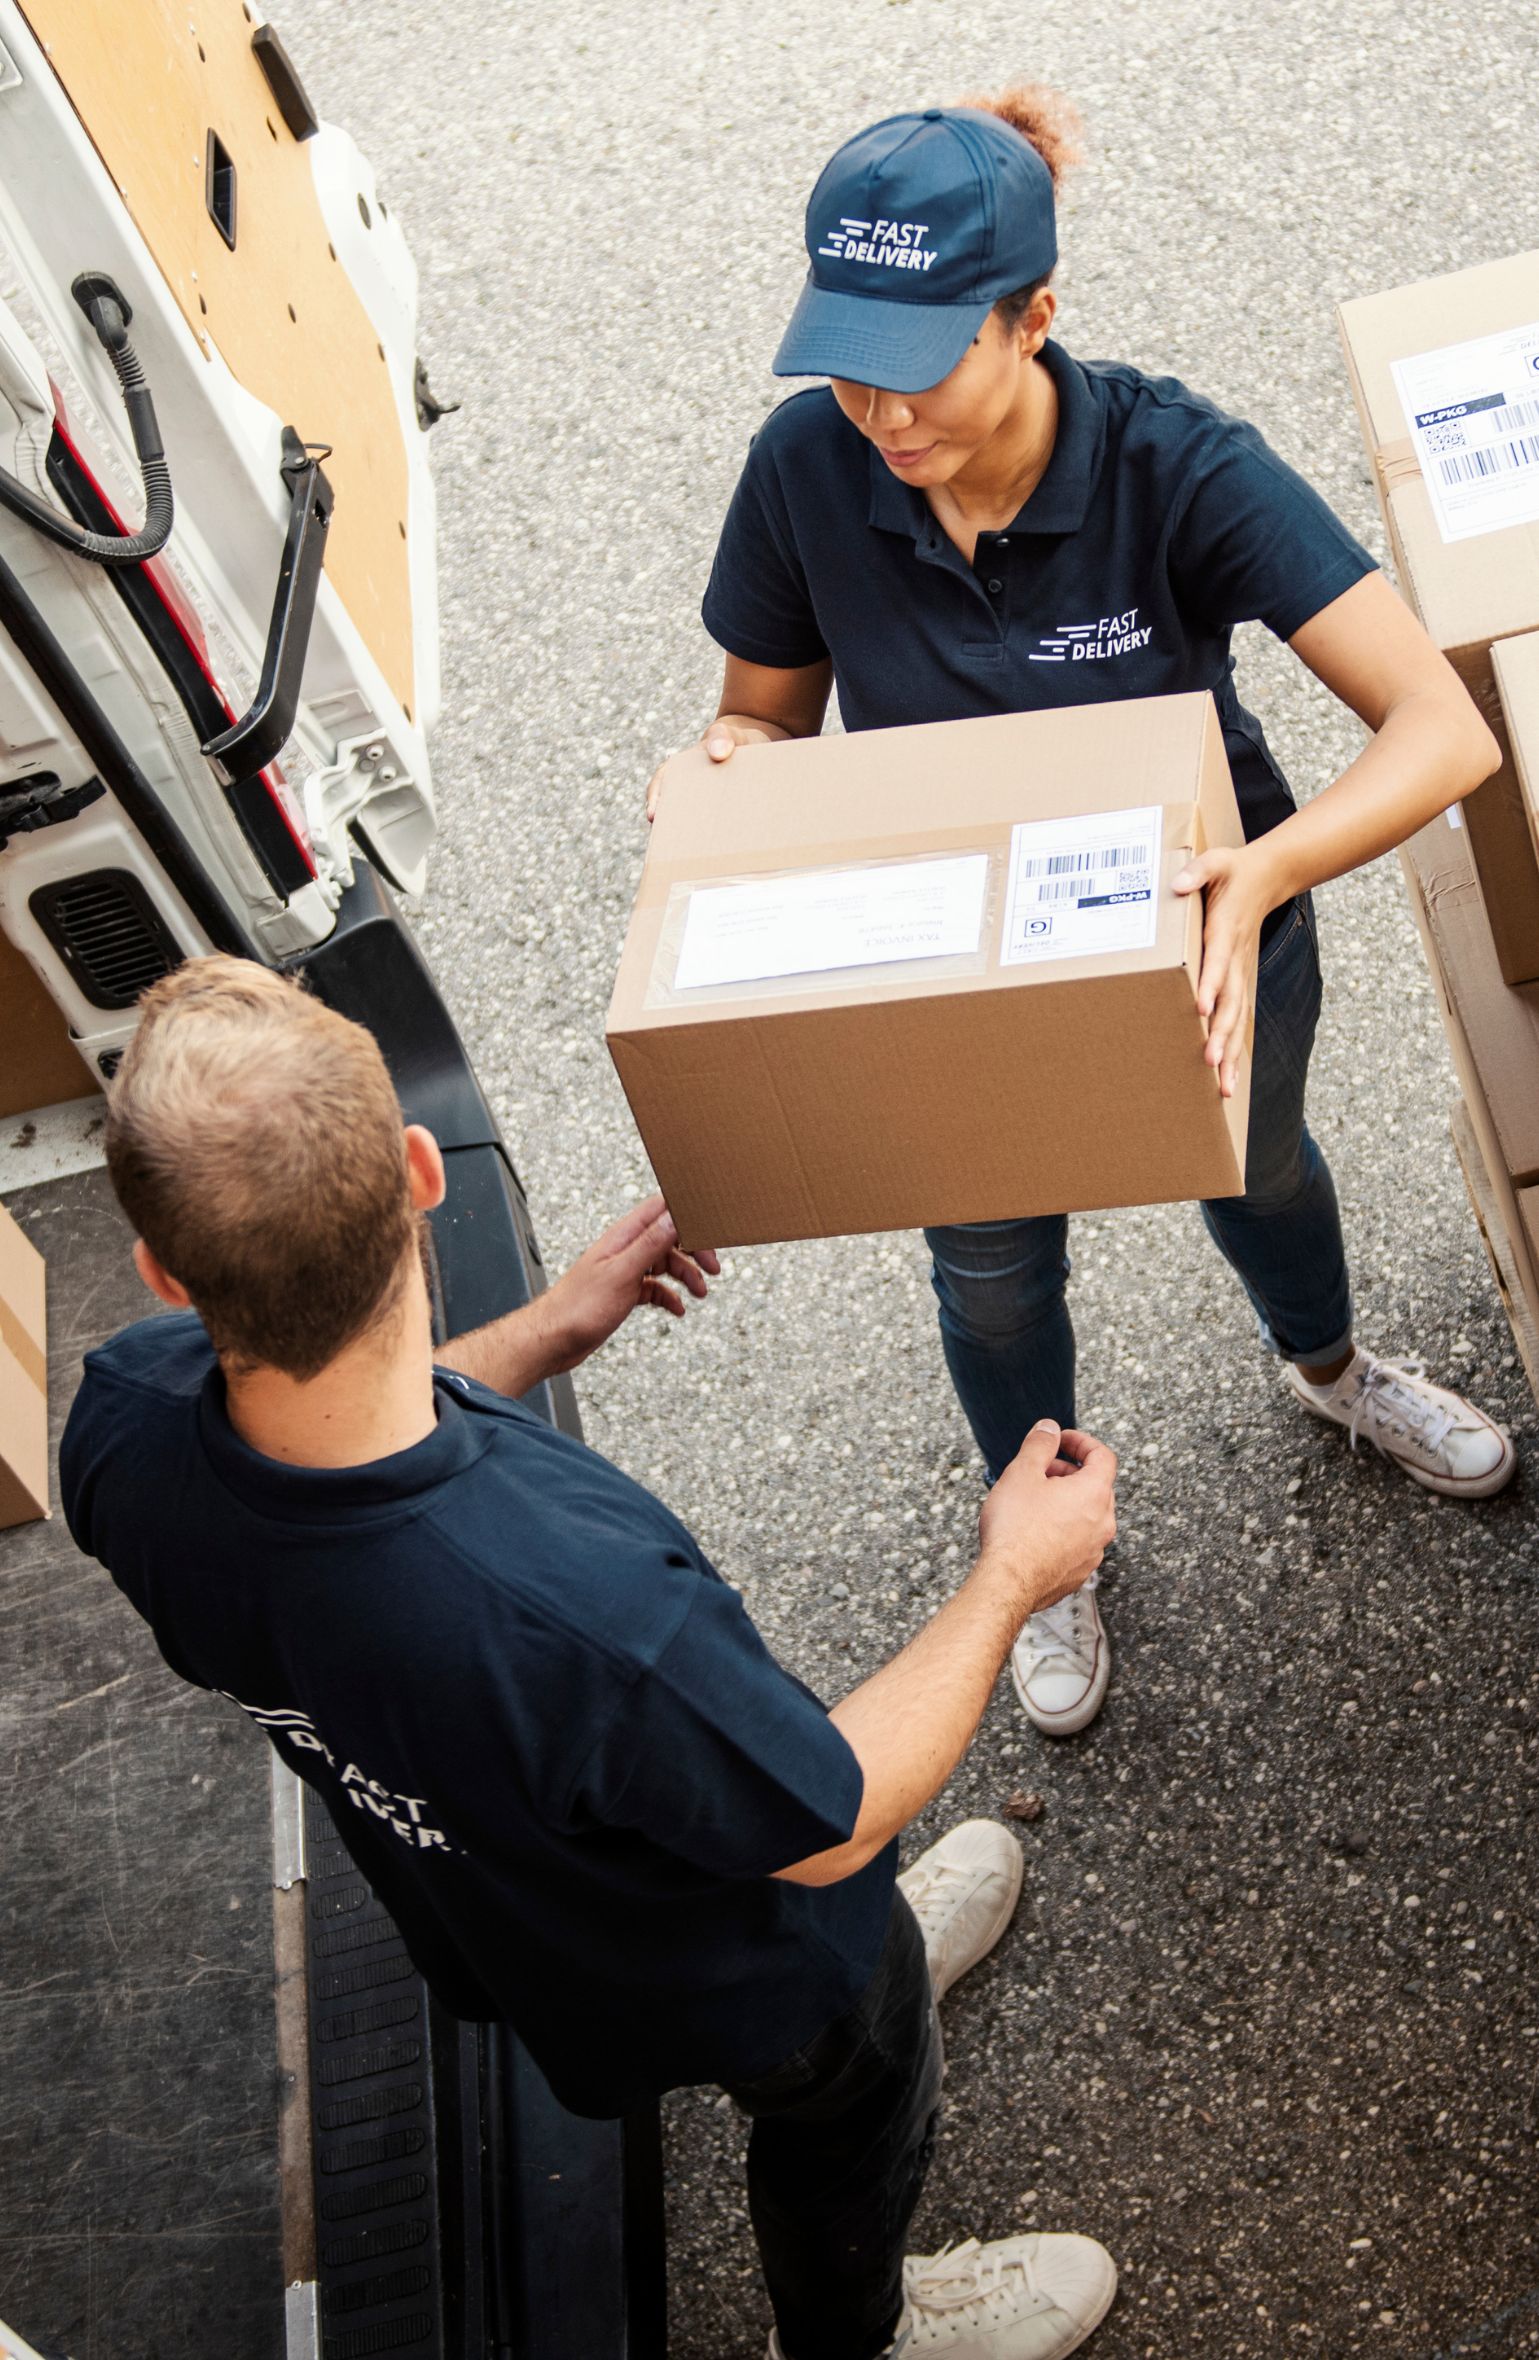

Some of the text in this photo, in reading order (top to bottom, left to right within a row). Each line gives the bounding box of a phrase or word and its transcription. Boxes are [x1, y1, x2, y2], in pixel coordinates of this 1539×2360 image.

[871, 219, 929, 248] FAST
[844, 240, 938, 271] DELIVERY
[1419, 405, 1468, 425] W-PKG
[1097, 608, 1139, 639] FAST
[1071, 626, 1153, 661] DELIVERY
[1030, 921, 1047, 934] G
